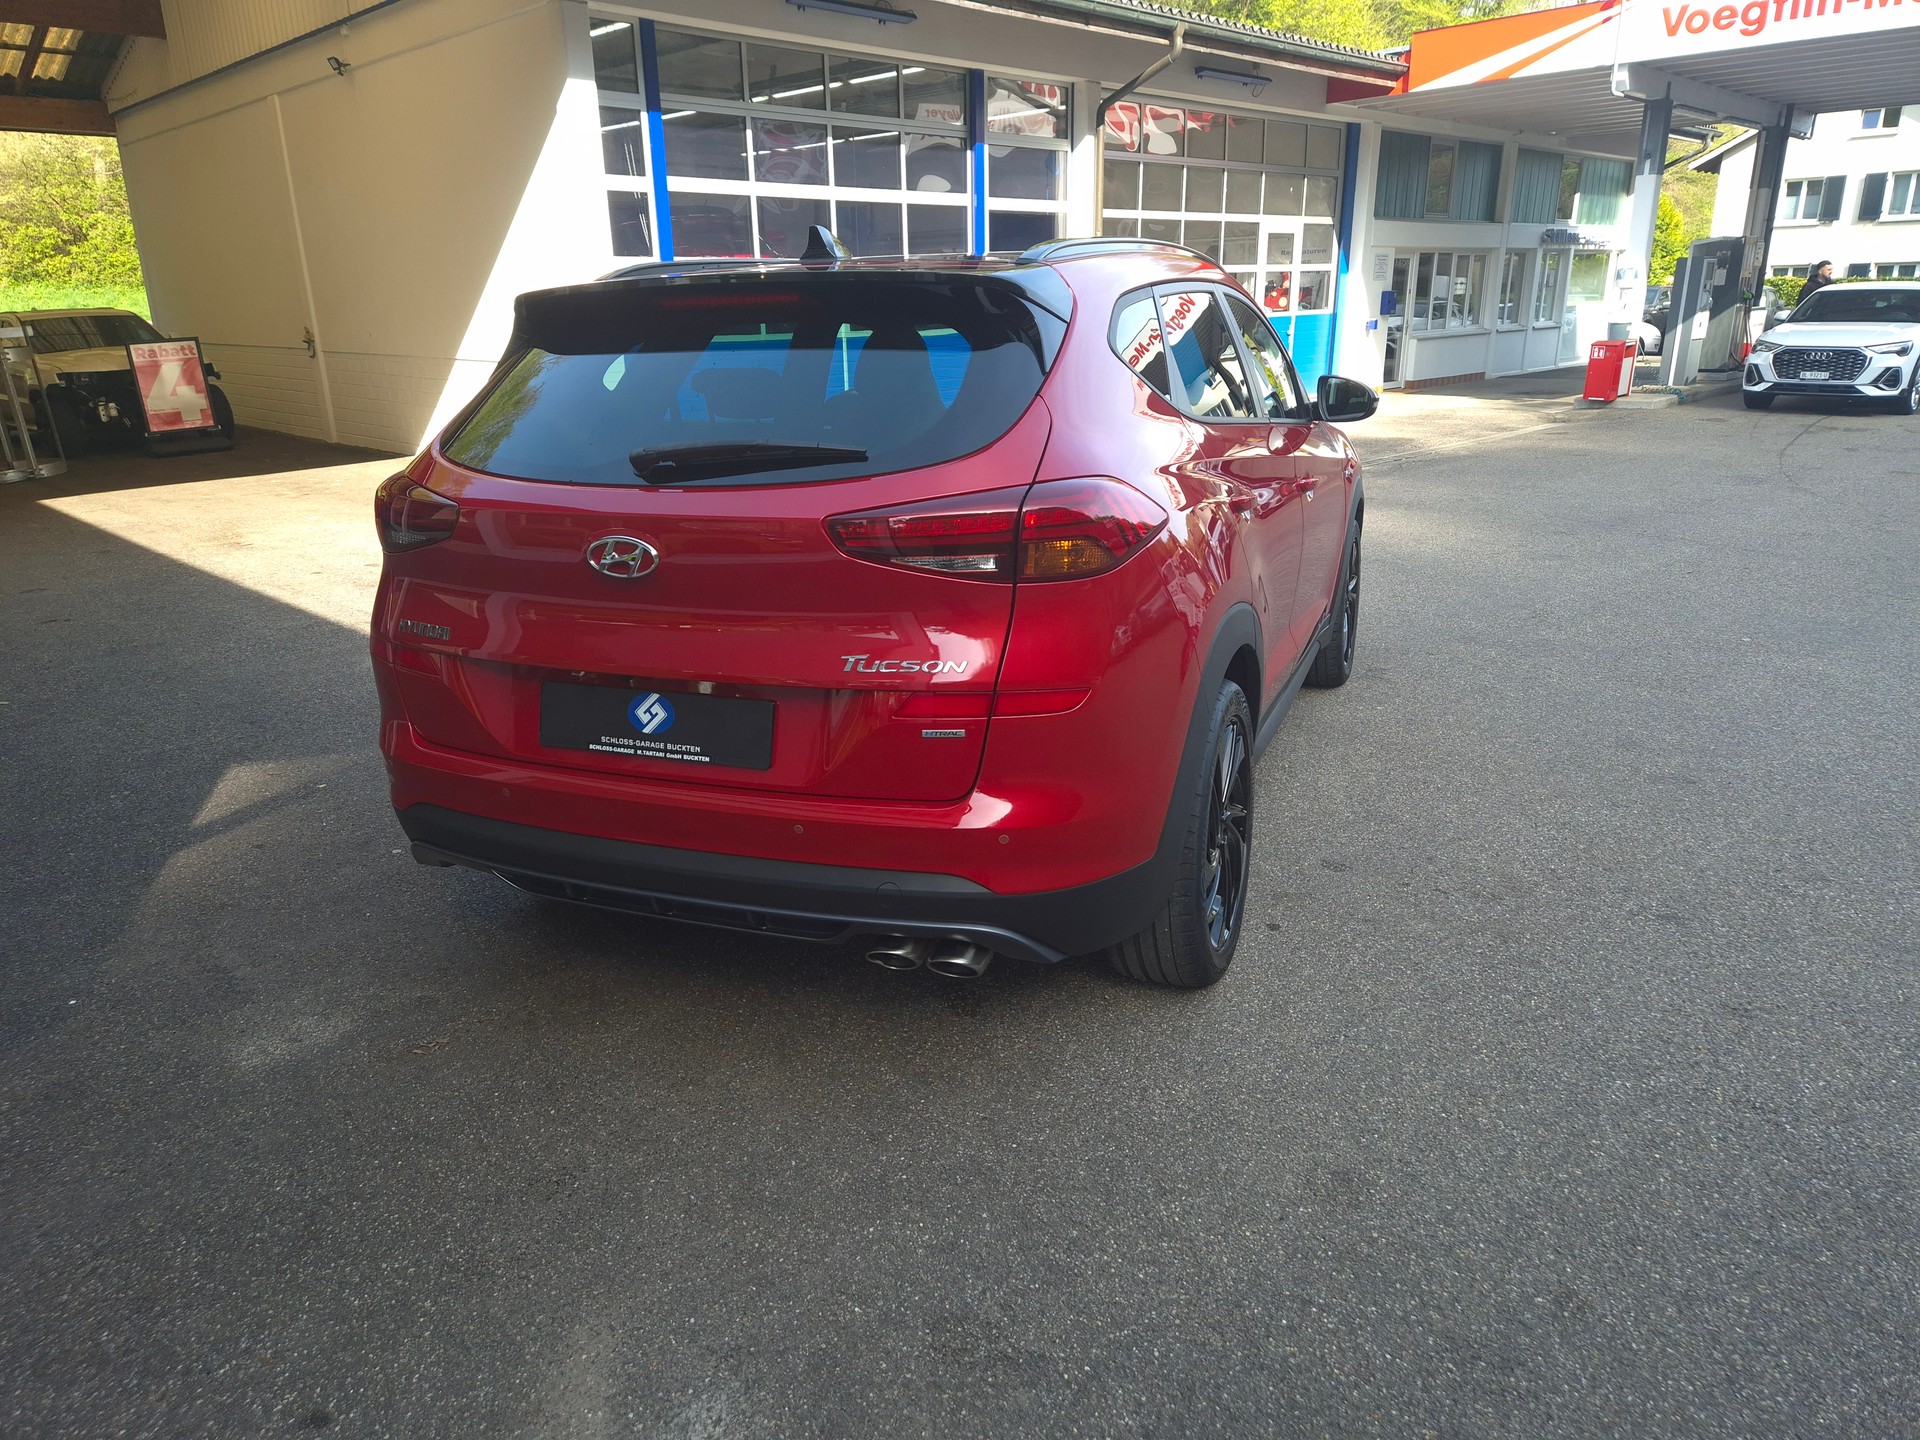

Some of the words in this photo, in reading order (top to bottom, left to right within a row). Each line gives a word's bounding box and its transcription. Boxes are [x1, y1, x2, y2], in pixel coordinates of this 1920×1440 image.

[1662, 0, 1920, 37] Voegtlin-
[133, 344, 197, 360] Rabatt
[146, 361, 208, 422] 4
[399, 618, 451, 641] HYUNDAI
[841, 653, 969, 674] TUCSON
[589, 744, 635, 755] SCHLOSS-GARAGE
[666, 752, 682, 760] GmbH
[683, 754, 710, 762] BUCKTEN
[601, 736, 665, 750] SCHLOSS-GARAGE
[667, 743, 701, 753] BUCKTEN
